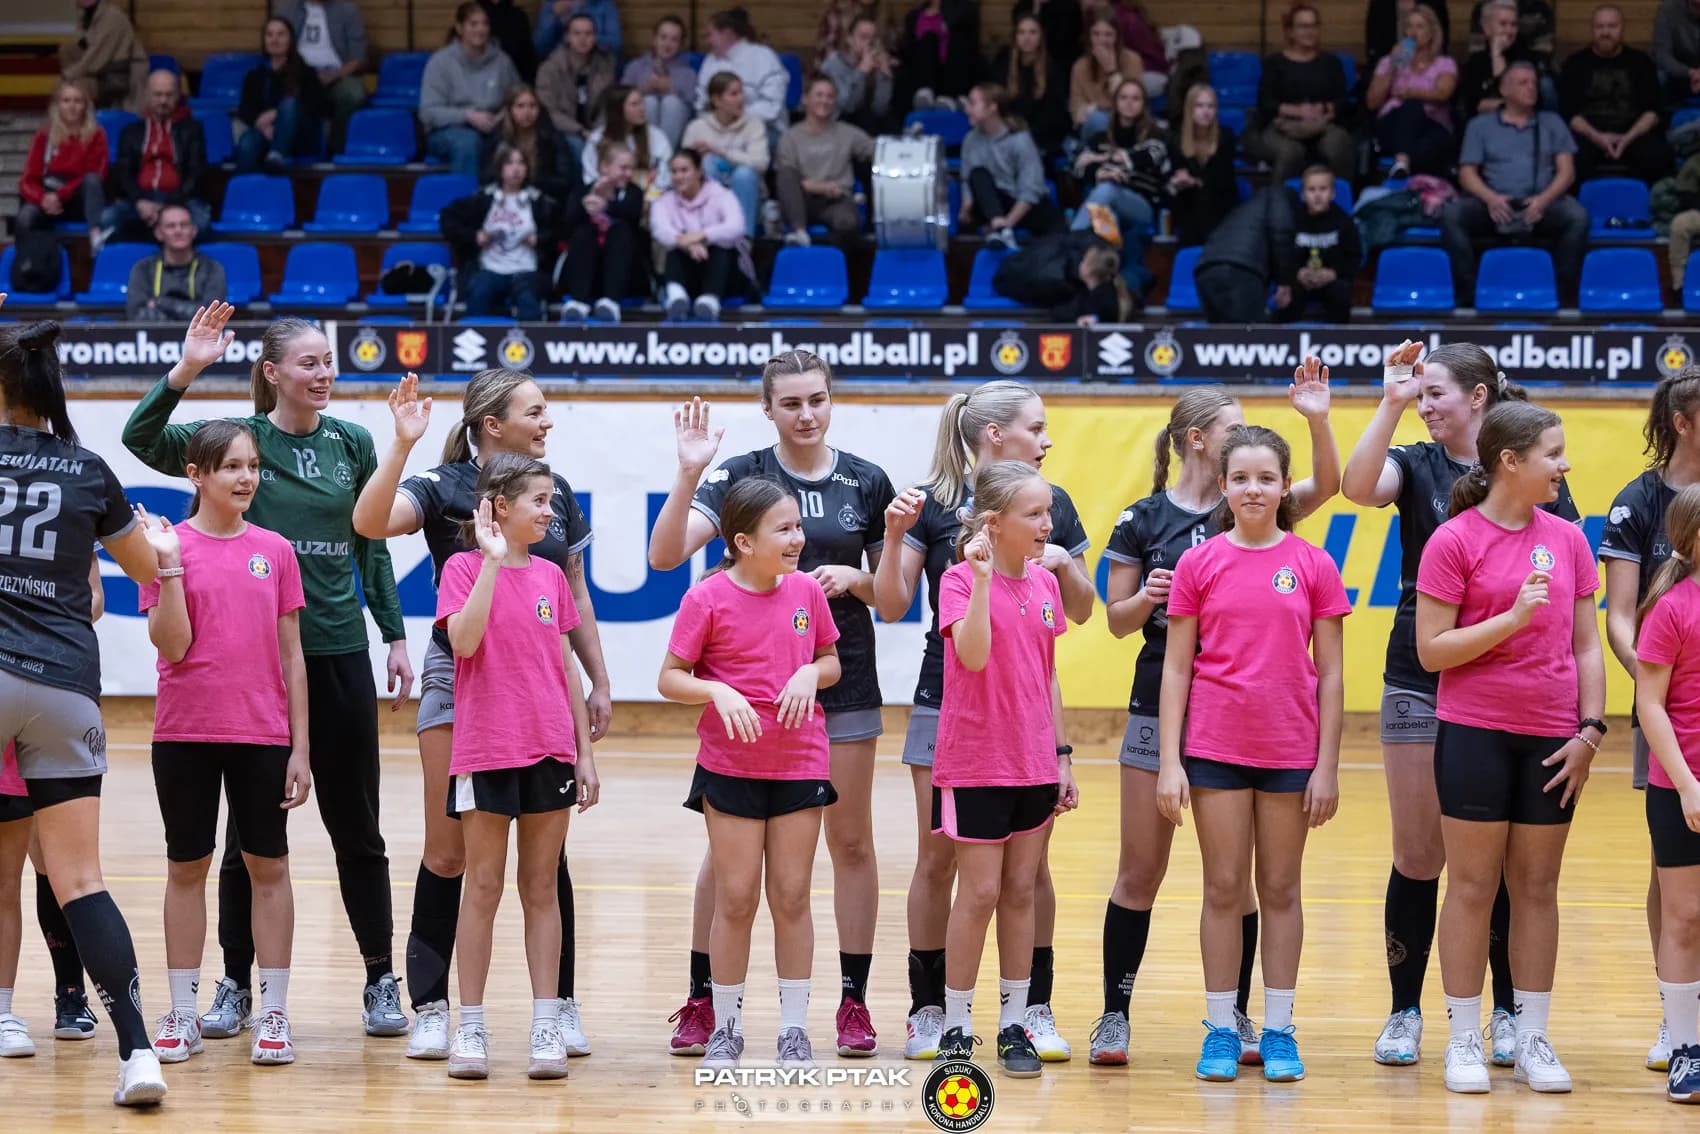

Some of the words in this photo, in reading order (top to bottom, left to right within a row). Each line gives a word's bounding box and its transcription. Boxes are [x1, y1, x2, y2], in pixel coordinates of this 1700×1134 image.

[0, 453, 84, 476] EWIATAN
[292, 447, 322, 479] 12
[798, 488, 825, 518] 10
[1191, 523, 1206, 548] 6
